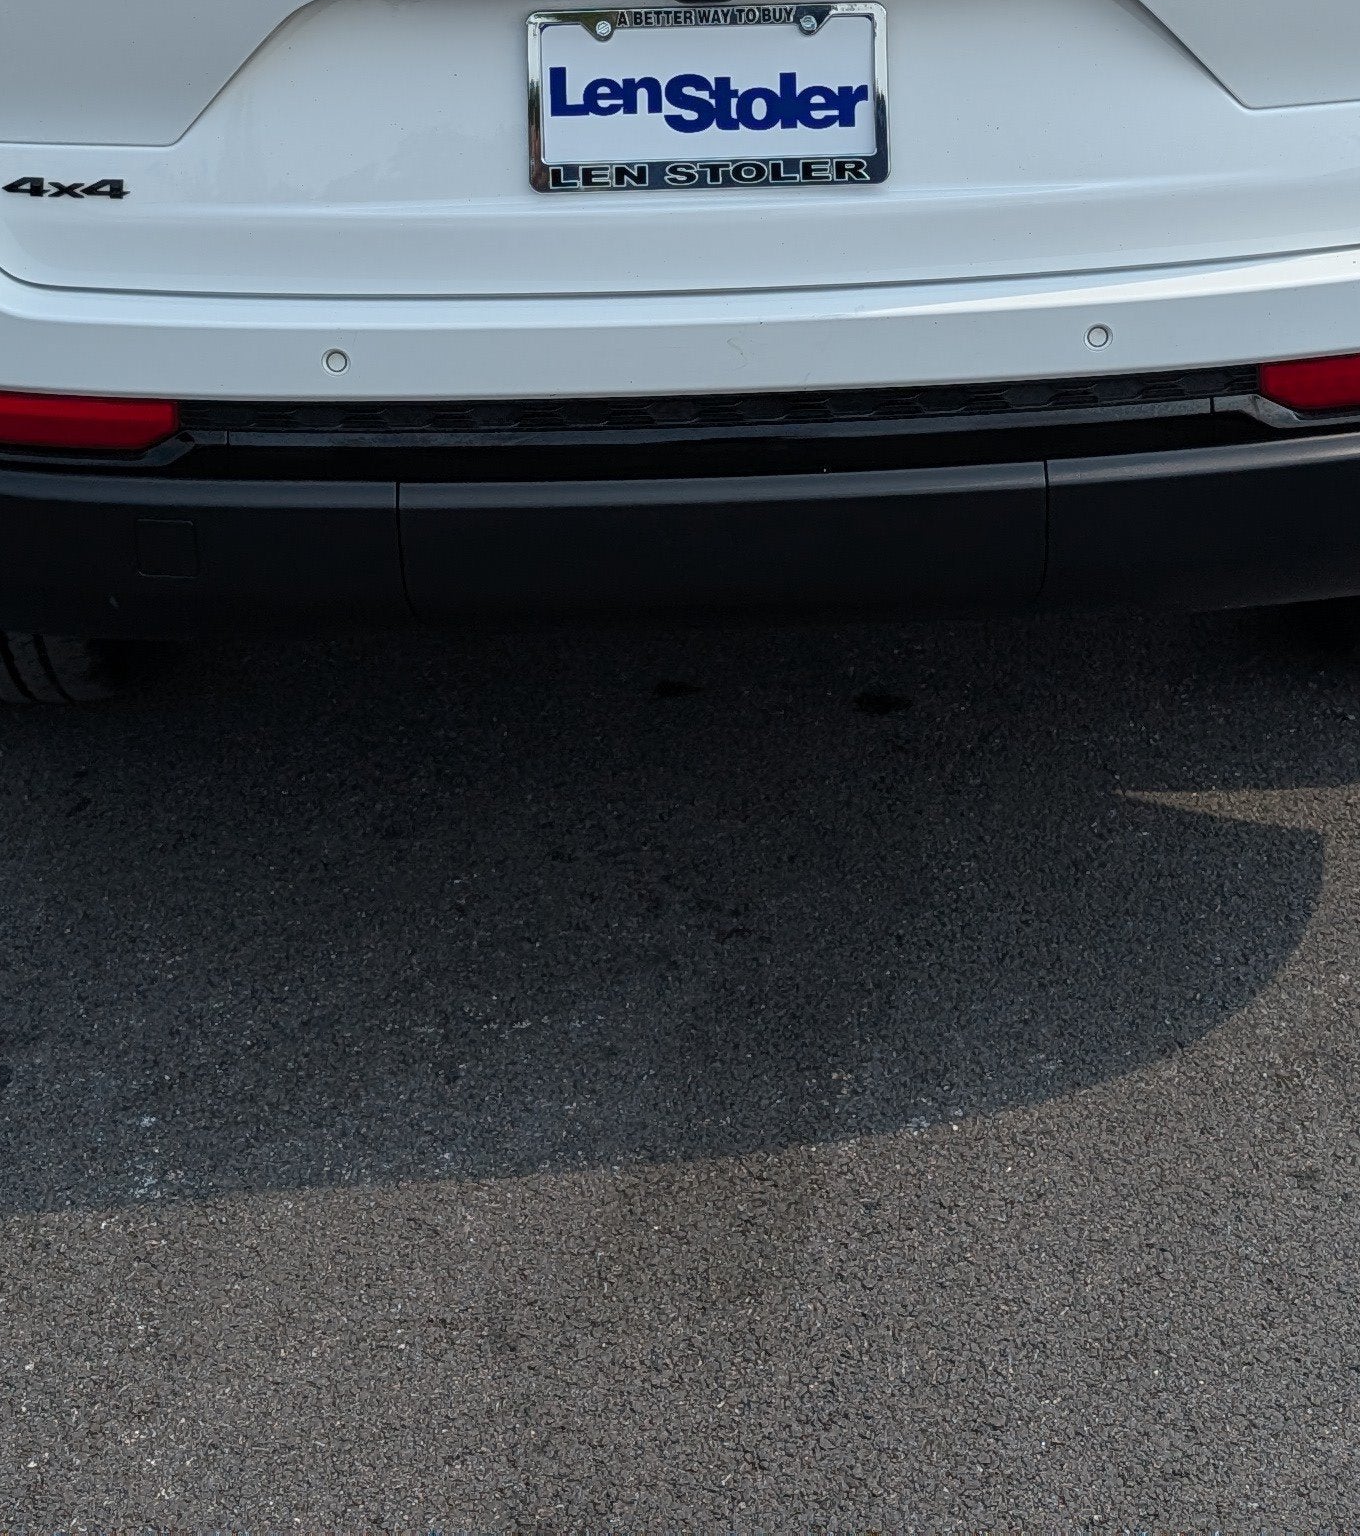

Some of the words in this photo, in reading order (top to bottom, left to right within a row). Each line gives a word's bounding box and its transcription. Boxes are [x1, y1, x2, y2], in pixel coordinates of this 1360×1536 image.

[616, 10, 630, 27] A
[633, 9, 696, 27] BETTER
[696, 8, 734, 25] WAY
[735, 7, 760, 24] TO
[760, 5, 797, 24] BUY
[548, 163, 649, 190] LEN
[663, 158, 871, 187] STOLER
[1, 175, 131, 200] 4x4
